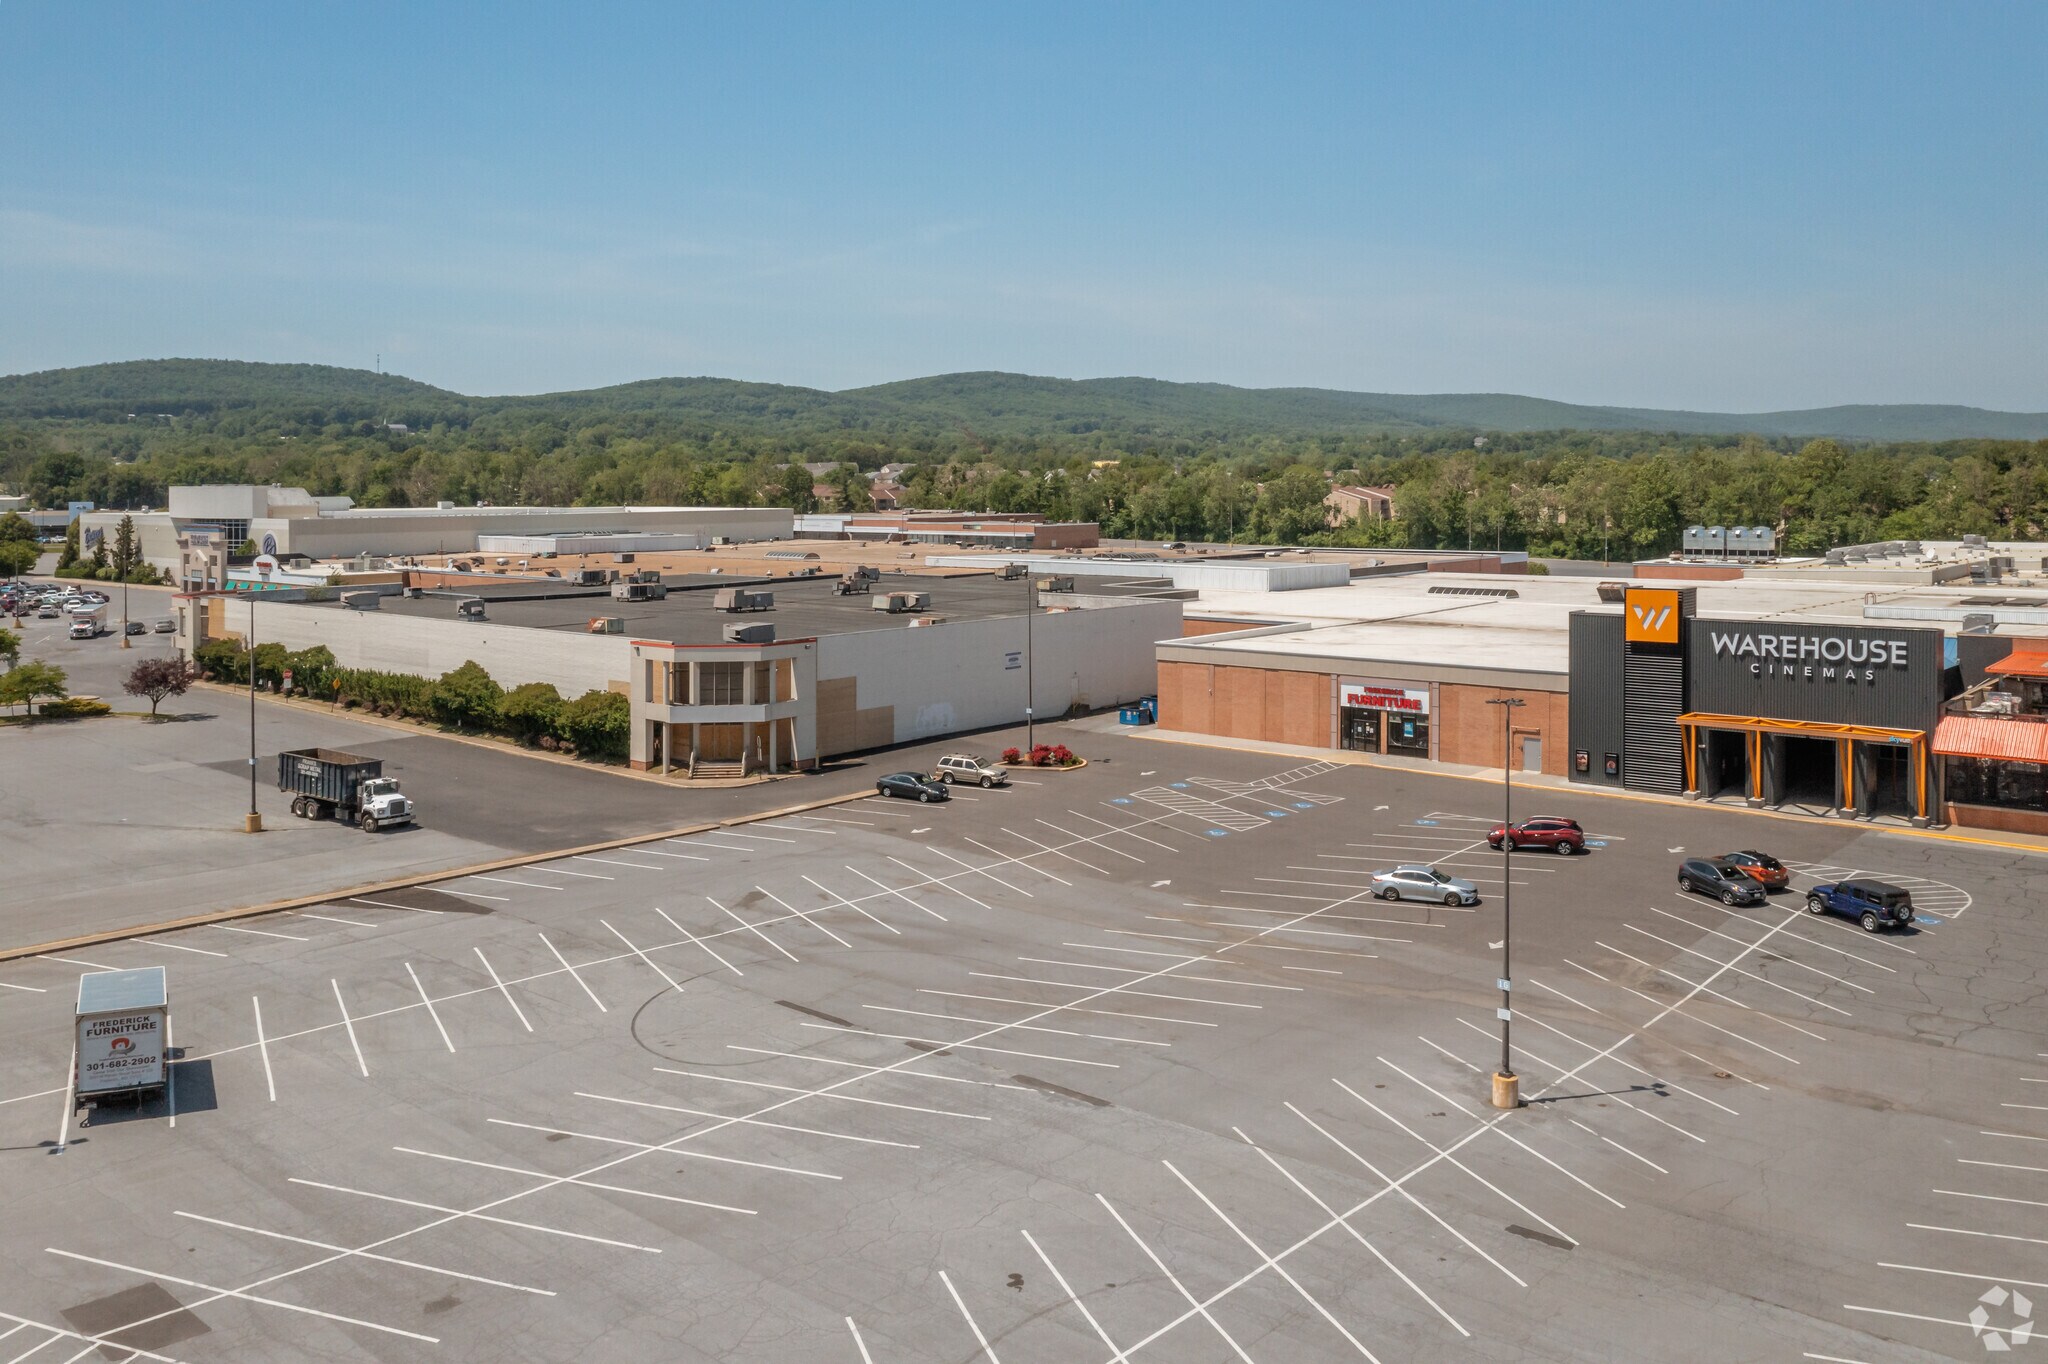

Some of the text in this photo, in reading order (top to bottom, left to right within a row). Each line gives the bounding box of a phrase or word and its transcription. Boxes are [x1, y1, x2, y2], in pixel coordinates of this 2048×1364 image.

[1711, 632, 1907, 665] WAREHOUSE
[1750, 663, 1875, 680] CINEMAS
[1347, 693, 1422, 710] FURNITURE
[86, 1021, 157, 1037] FURNITURE
[92, 1016, 150, 1029] FREDERICK
[86, 1056, 156, 1072] 301-682-2902
